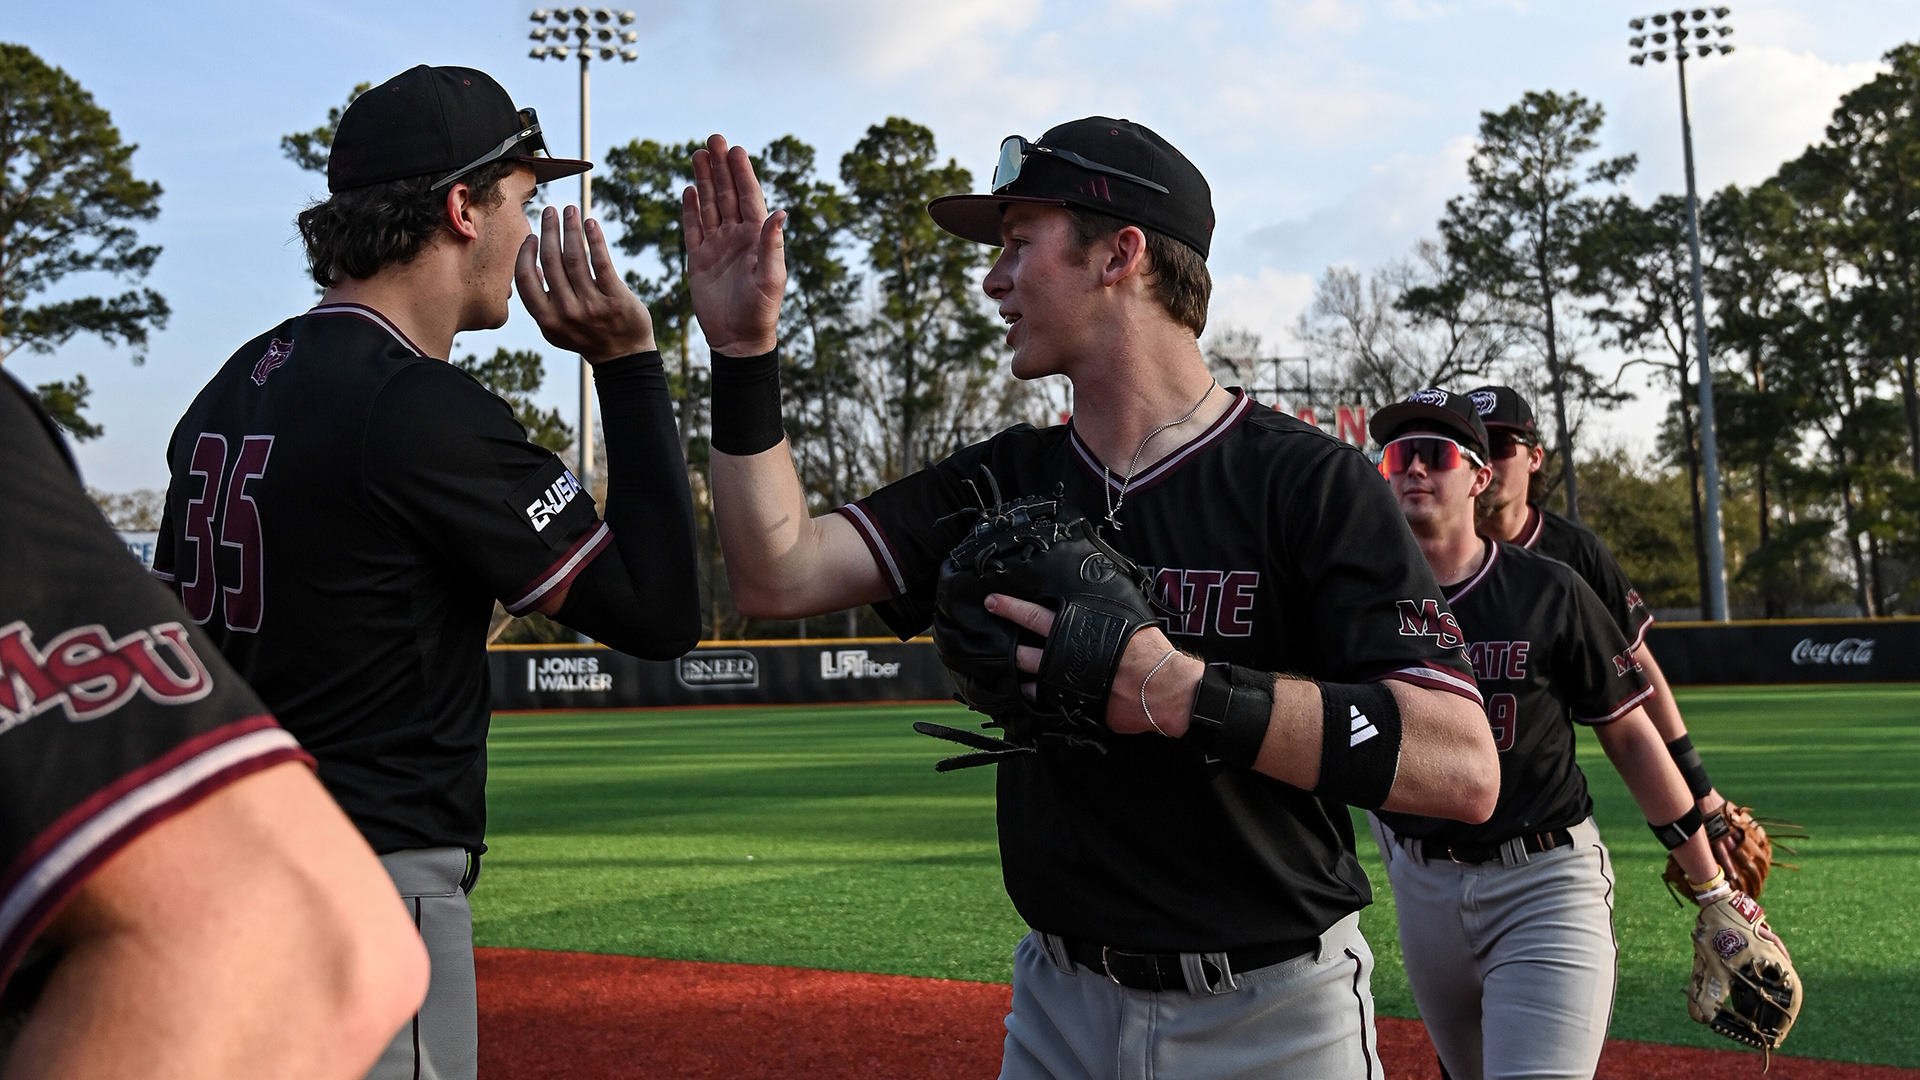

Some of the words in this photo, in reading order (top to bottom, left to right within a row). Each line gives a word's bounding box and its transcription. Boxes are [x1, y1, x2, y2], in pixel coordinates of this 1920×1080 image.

[181, 432, 276, 634] 35
[1139, 566, 1260, 637] ATE
[1396, 598, 1472, 666] MS
[538, 657, 599, 674] JONES
[689, 659, 754, 673] SNEED
[1466, 641, 1530, 679] ATE
[538, 673, 613, 691] WALKER
